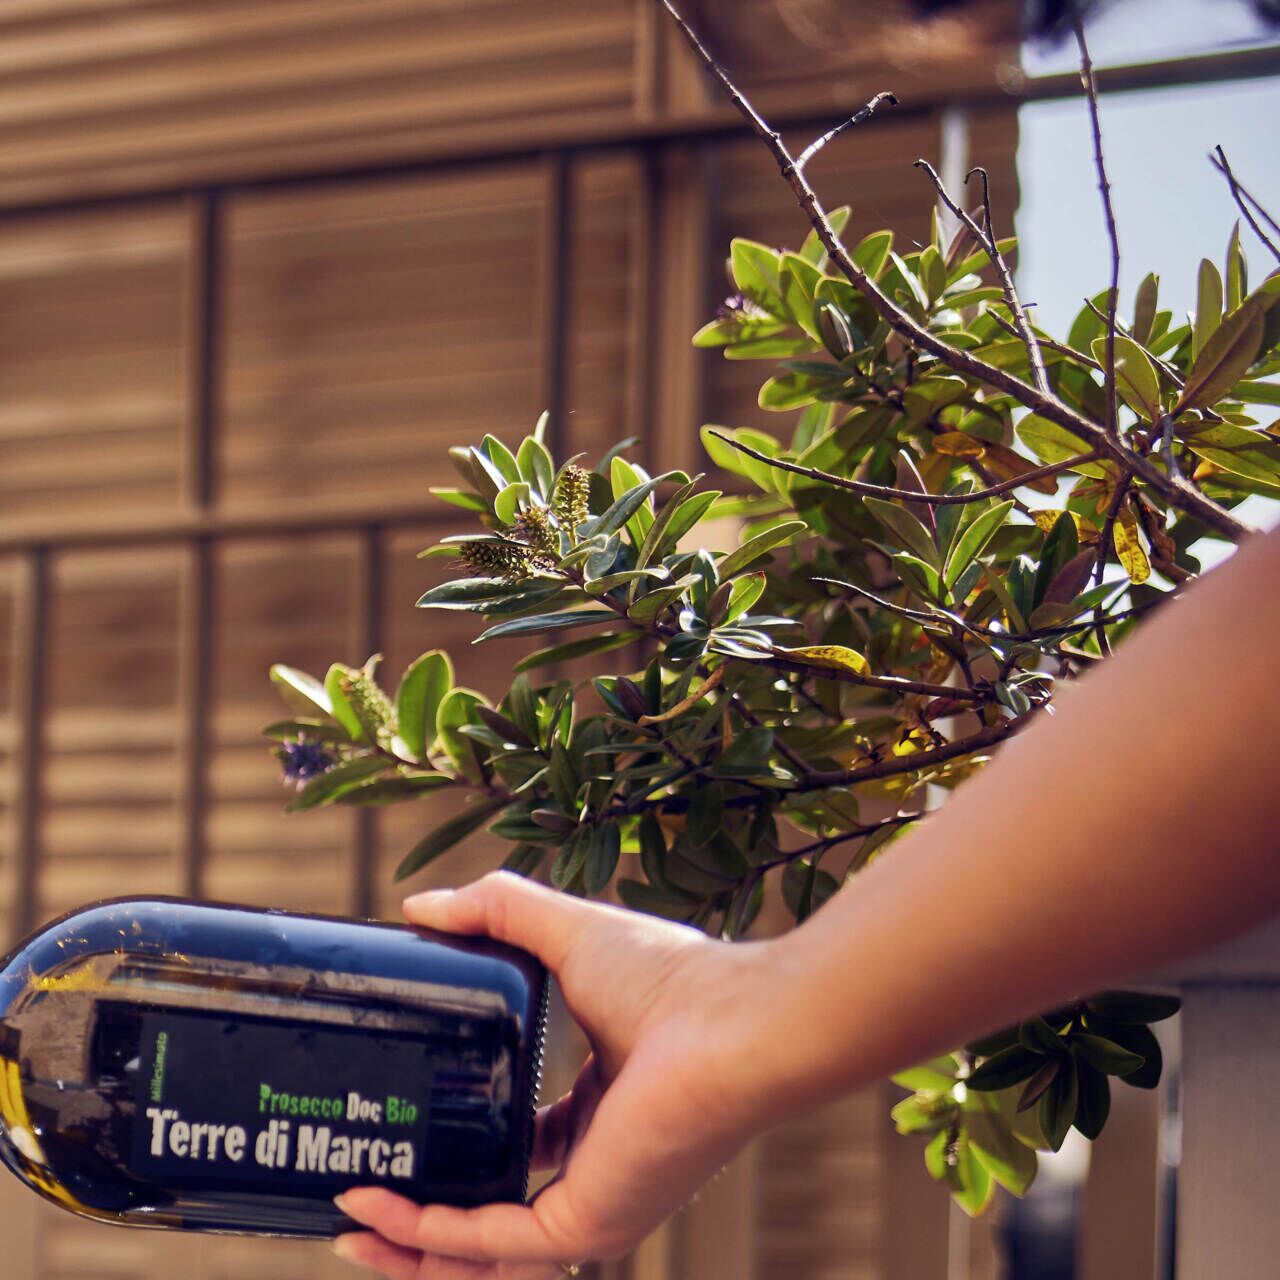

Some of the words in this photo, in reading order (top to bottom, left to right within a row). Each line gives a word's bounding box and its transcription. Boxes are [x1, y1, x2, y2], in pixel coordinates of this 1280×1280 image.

[258, 1082, 342, 1117] Prosecco
[346, 1092, 381, 1123] Doc
[386, 1096, 419, 1125] Bio
[146, 1108, 245, 1161] Terre
[255, 1120, 289, 1168] di
[295, 1125, 414, 1178] Marca
